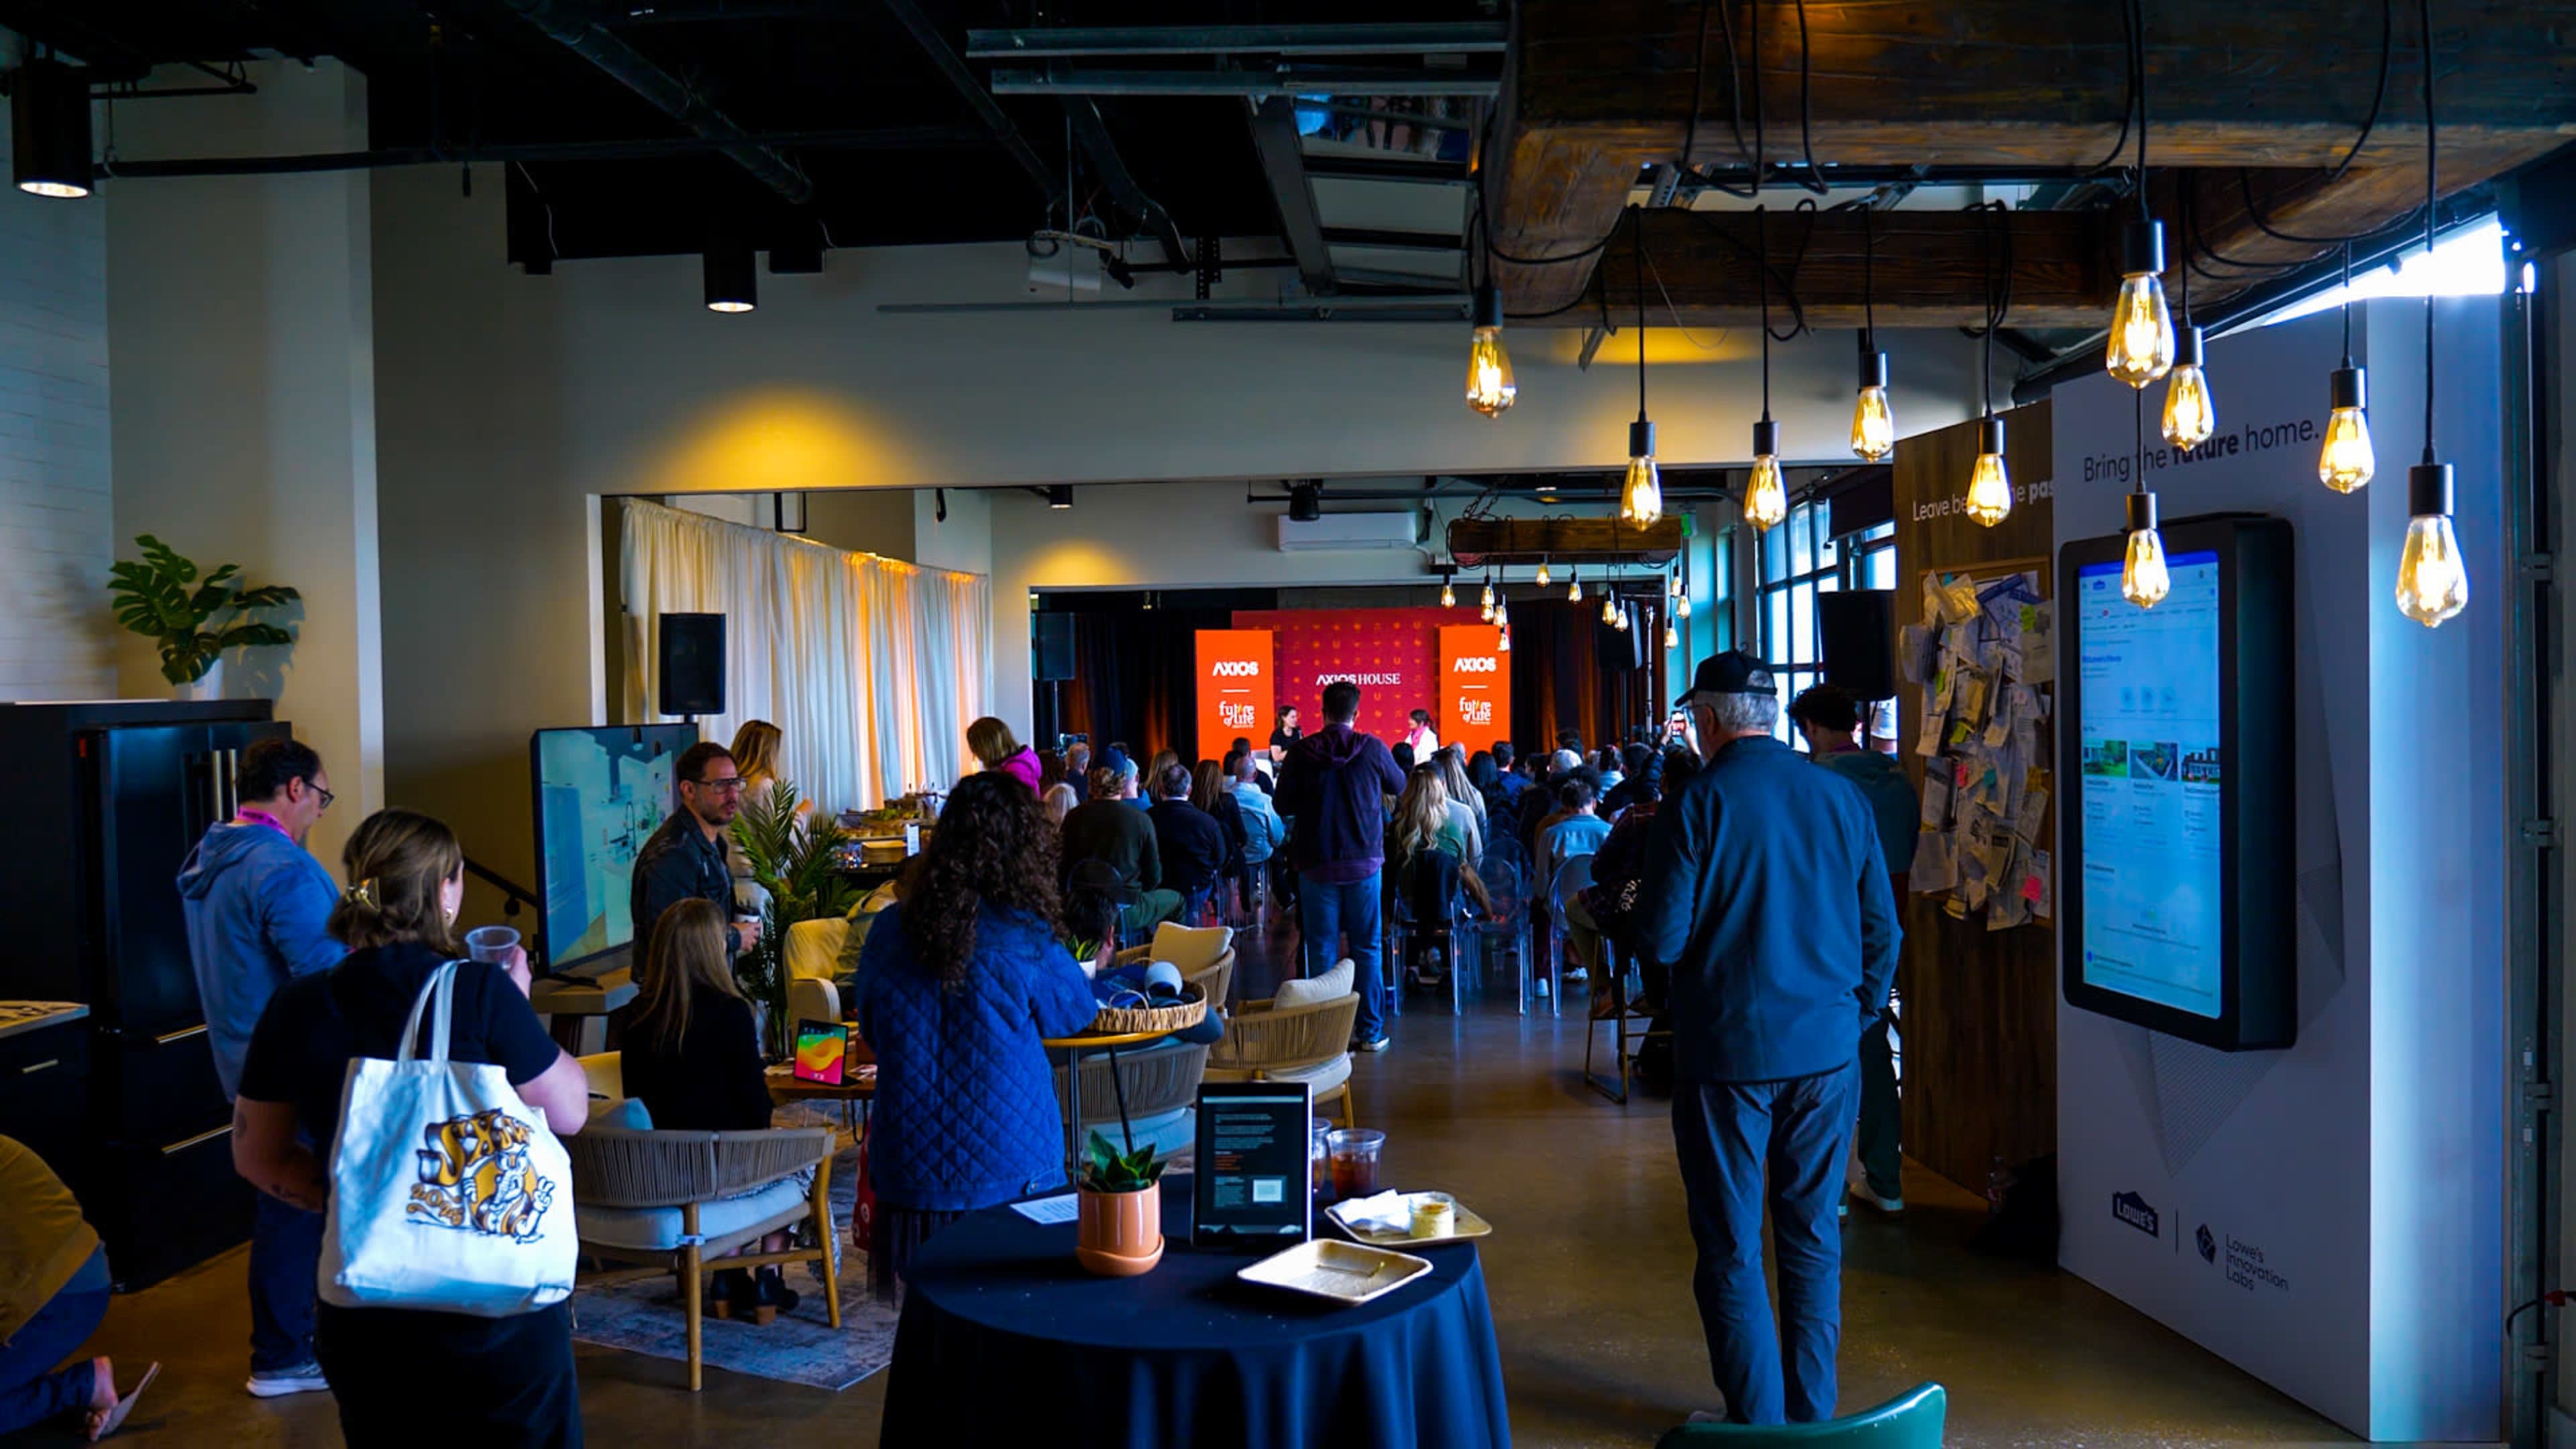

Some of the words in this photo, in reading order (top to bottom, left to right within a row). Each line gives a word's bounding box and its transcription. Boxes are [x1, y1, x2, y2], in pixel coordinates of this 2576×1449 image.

[2084, 454, 2130, 482] Bring
[2135, 445, 2167, 472] he
[2246, 419, 2319, 451] home.
[1913, 500, 1949, 521] Leave
[1213, 661, 1259, 677] AXIOS
[1454, 657, 1497, 672] AXIOS
[1358, 673, 1401, 685] HOUSE
[2226, 1234, 2264, 1263] Lowe's
[2226, 1249, 2288, 1291] Innovation
[2226, 1265, 2254, 1291] Labs
